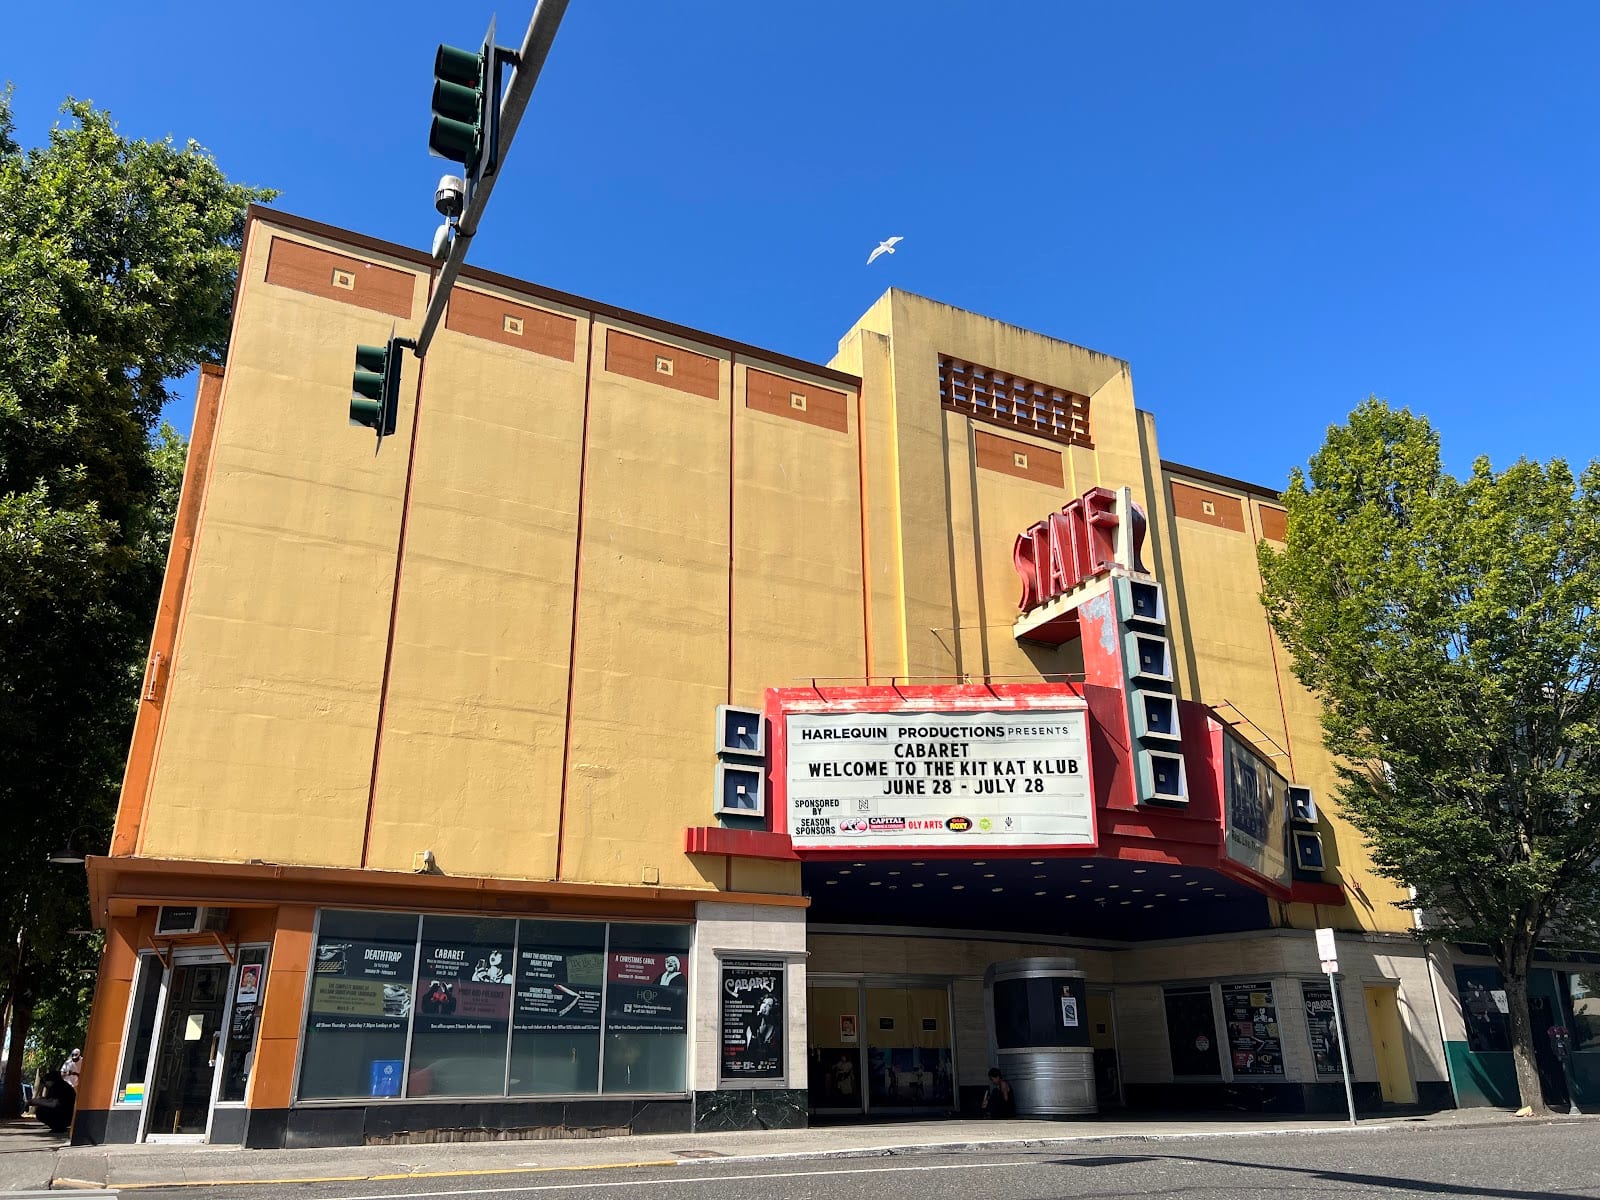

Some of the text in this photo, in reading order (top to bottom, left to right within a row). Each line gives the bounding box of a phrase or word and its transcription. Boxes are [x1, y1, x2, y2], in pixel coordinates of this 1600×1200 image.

[1013, 487, 1124, 613] STATE
[802, 726, 1069, 740] HARLEQUIN PRODUCTIONS PRESENTS
[894, 743, 969, 758] CABARET
[808, 759, 1079, 777] WELCOME TO THE KIT KAT KLUB
[883, 780, 926, 794] JUNE
[932, 779, 952, 794] 28
[974, 778, 1016, 794] JULY
[1024, 778, 1044, 793] 28
[795, 799, 840, 808] SPONSORED
[812, 807, 822, 816] BY
[795, 826, 836, 835] SPONSORS
[800, 818, 830, 827] SEASON
[908, 820, 922, 830] OLY
[923, 820, 943, 829] ARTS
[949, 822, 968, 830] ROXY
[364, 949, 402, 963] DEATHTRAP
[434, 948, 465, 961] CABARET
[725, 977, 777, 998] CABARET
